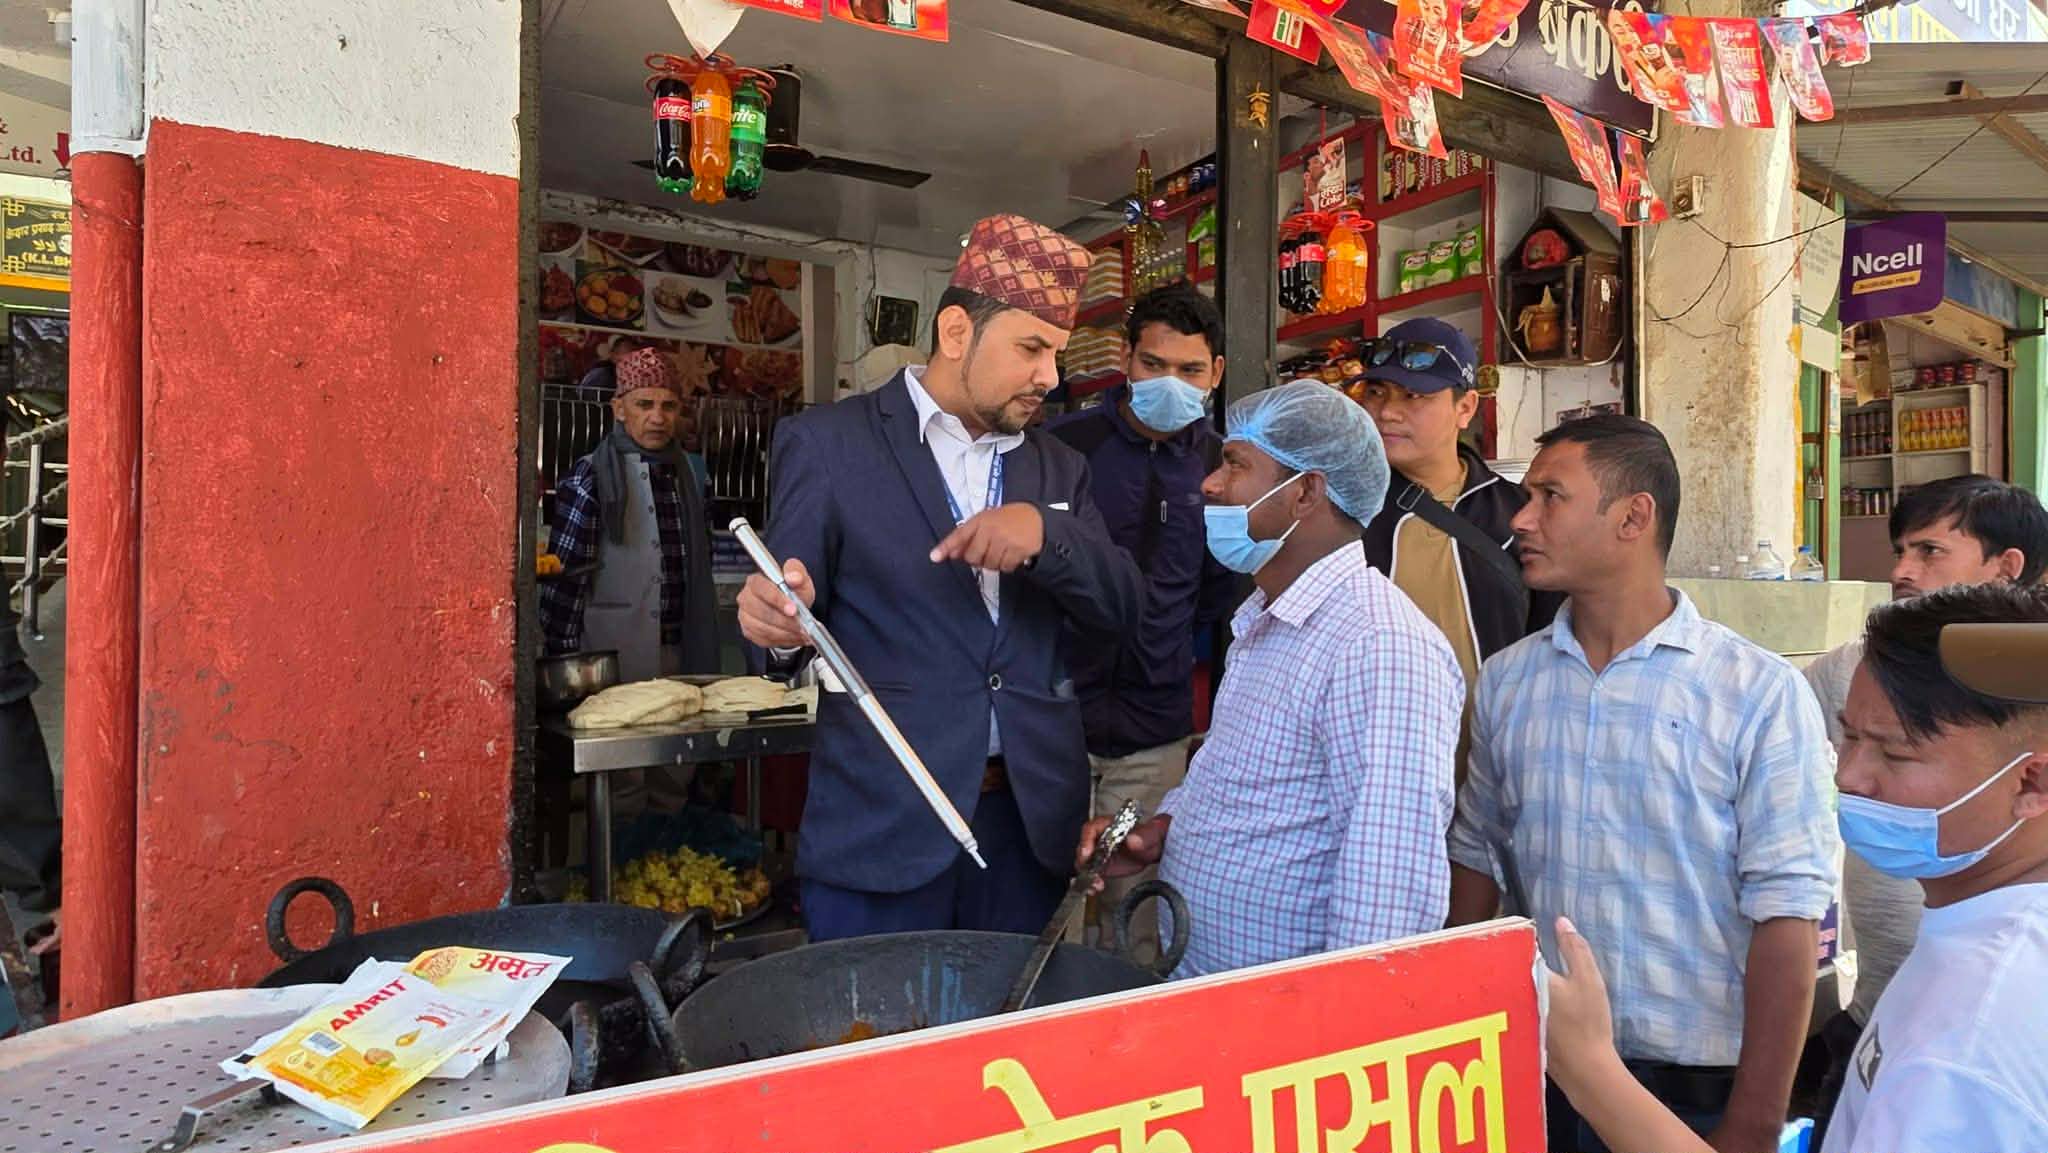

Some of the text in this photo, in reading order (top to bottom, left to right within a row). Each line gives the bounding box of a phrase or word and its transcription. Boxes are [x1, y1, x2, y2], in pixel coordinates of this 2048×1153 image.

[0, 143, 42, 164] td.
[1852, 243, 1924, 277] Ncell
[469, 951, 551, 981] अमृत
[329, 977, 410, 1032] AMRIT
